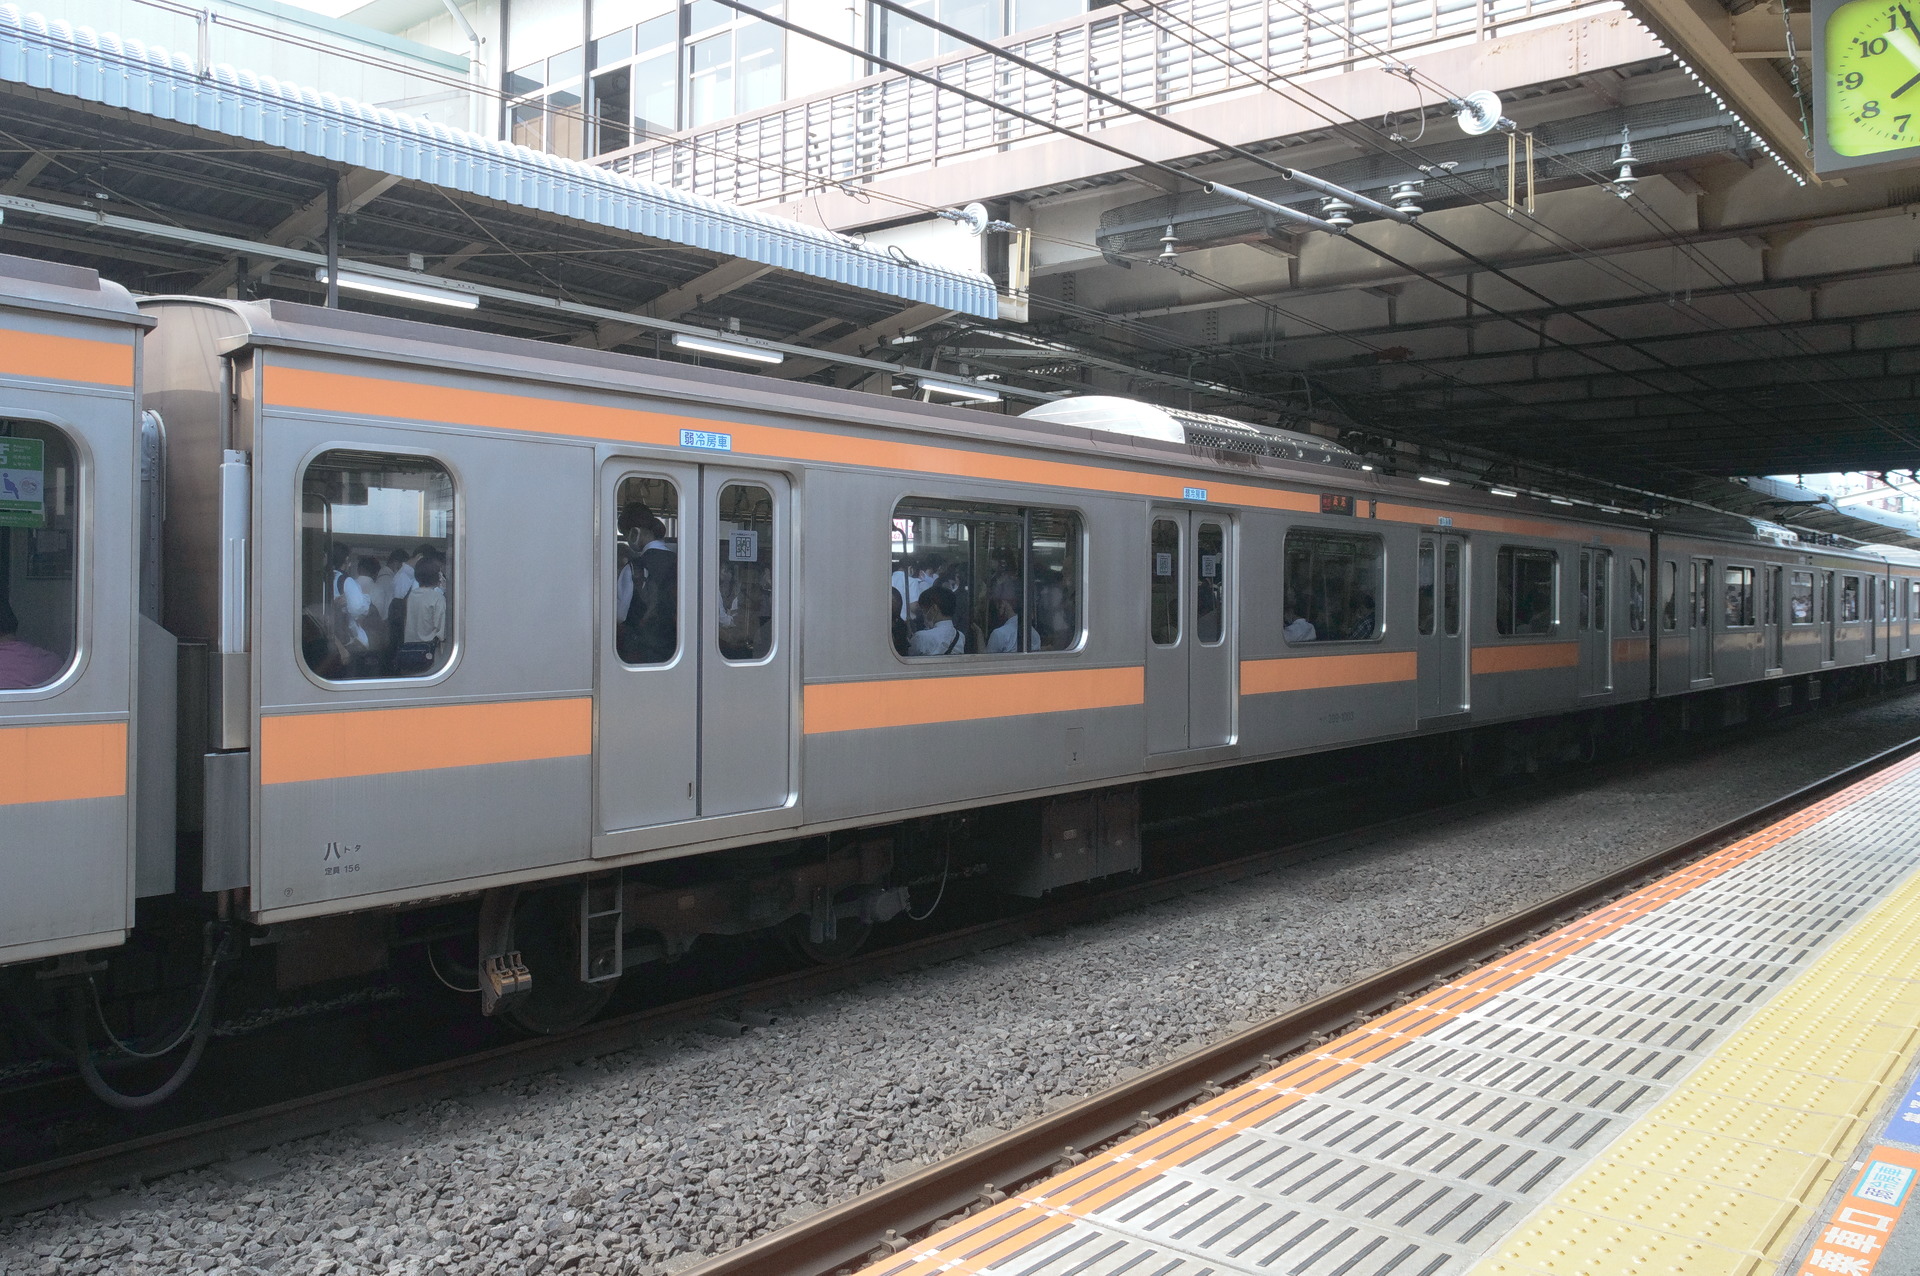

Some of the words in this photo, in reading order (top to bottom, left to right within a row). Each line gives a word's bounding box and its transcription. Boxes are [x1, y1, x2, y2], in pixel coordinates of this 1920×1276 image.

[1859, 37, 1888, 59] 10
[1845, 71, 1864, 91] 9
[1861, 100, 1881, 119] 8
[1893, 113, 1912, 133] 7
[684, 431, 728, 449] 弱冷房車
[344, 863, 361, 873] 156
[1803, 1207, 1894, 1276] 乗車口
